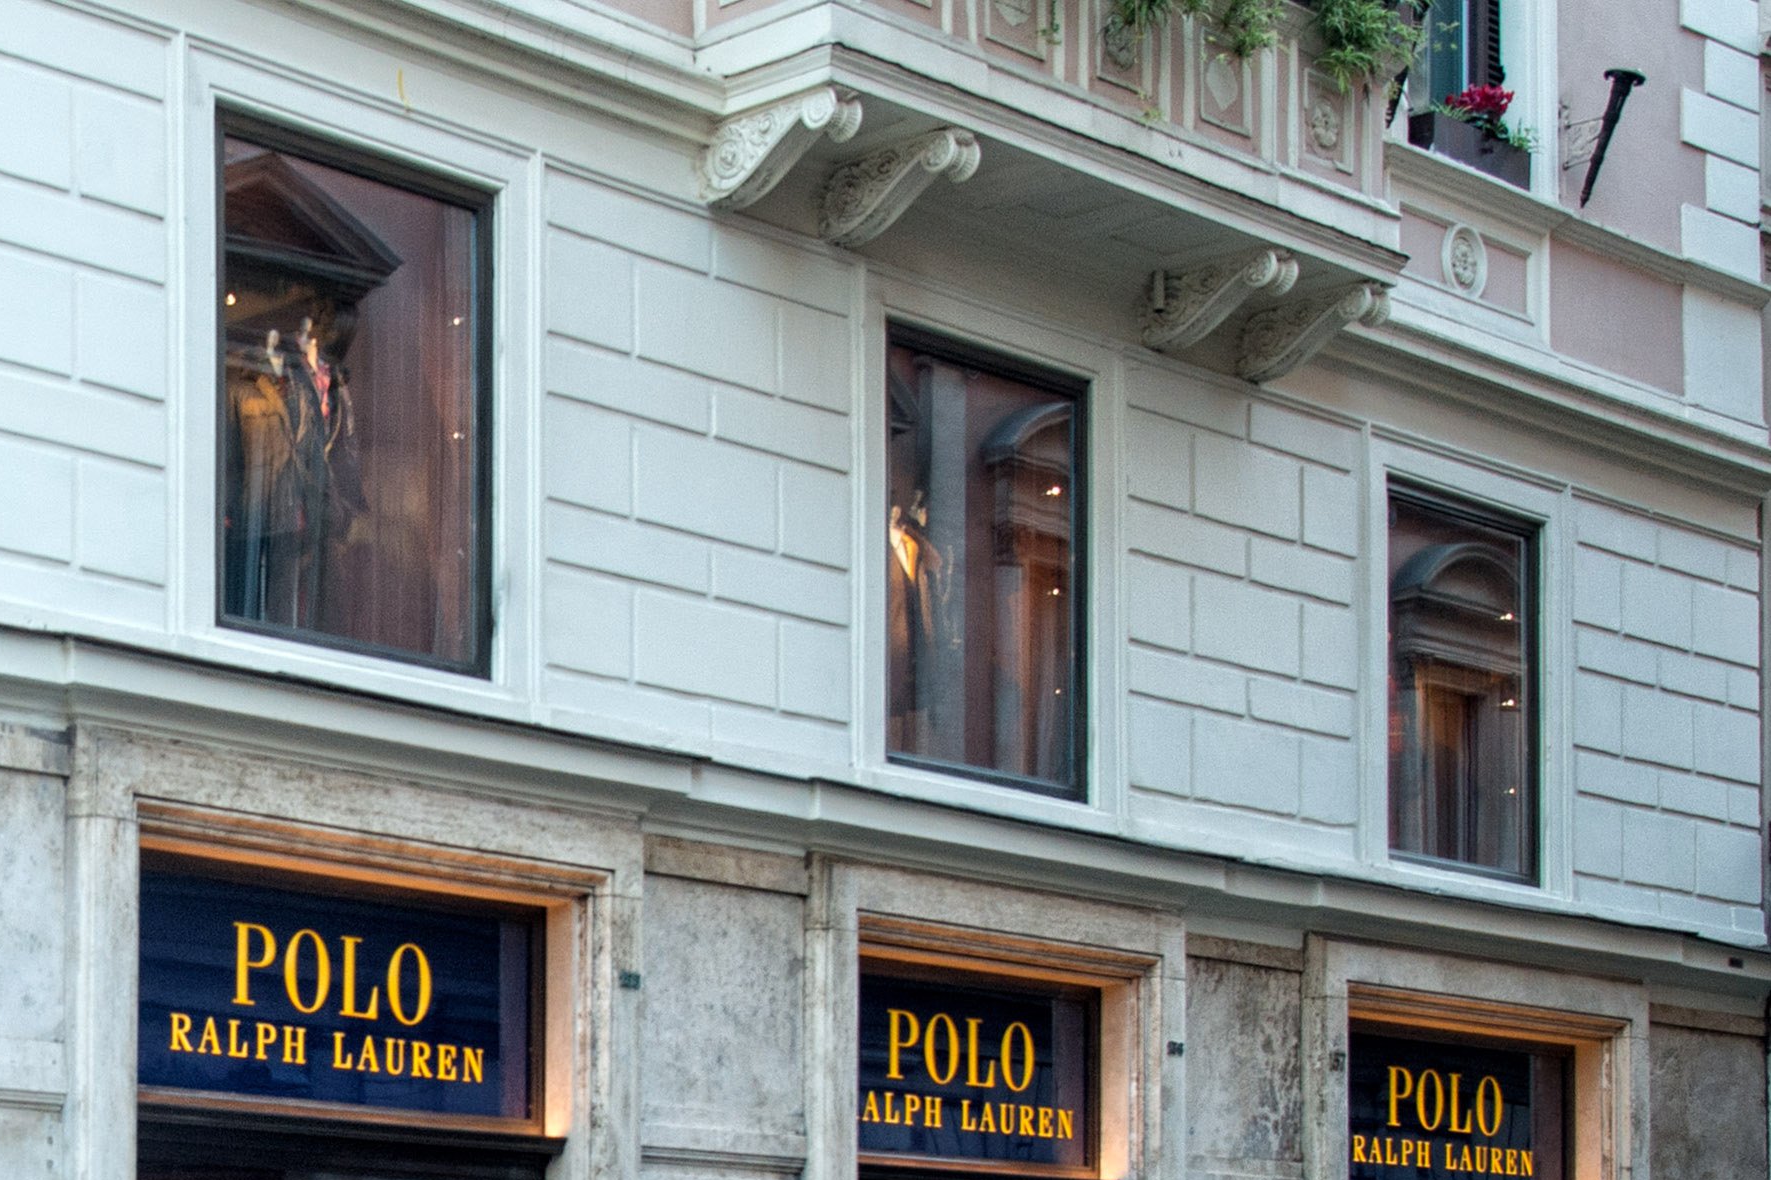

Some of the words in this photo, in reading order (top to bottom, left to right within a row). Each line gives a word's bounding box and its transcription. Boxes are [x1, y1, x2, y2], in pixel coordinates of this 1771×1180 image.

[232, 921, 433, 1026] POLO
[169, 1012, 307, 1066] RALPH
[333, 1031, 485, 1084] LAUREN
[886, 1008, 1036, 1093] POLO
[858, 1091, 942, 1129] ALPH
[961, 1099, 1074, 1140] LAUREN
[1387, 1065, 1504, 1138] POLO
[1352, 1134, 1431, 1169] RALPH
[1445, 1143, 1534, 1177] LAUREN
